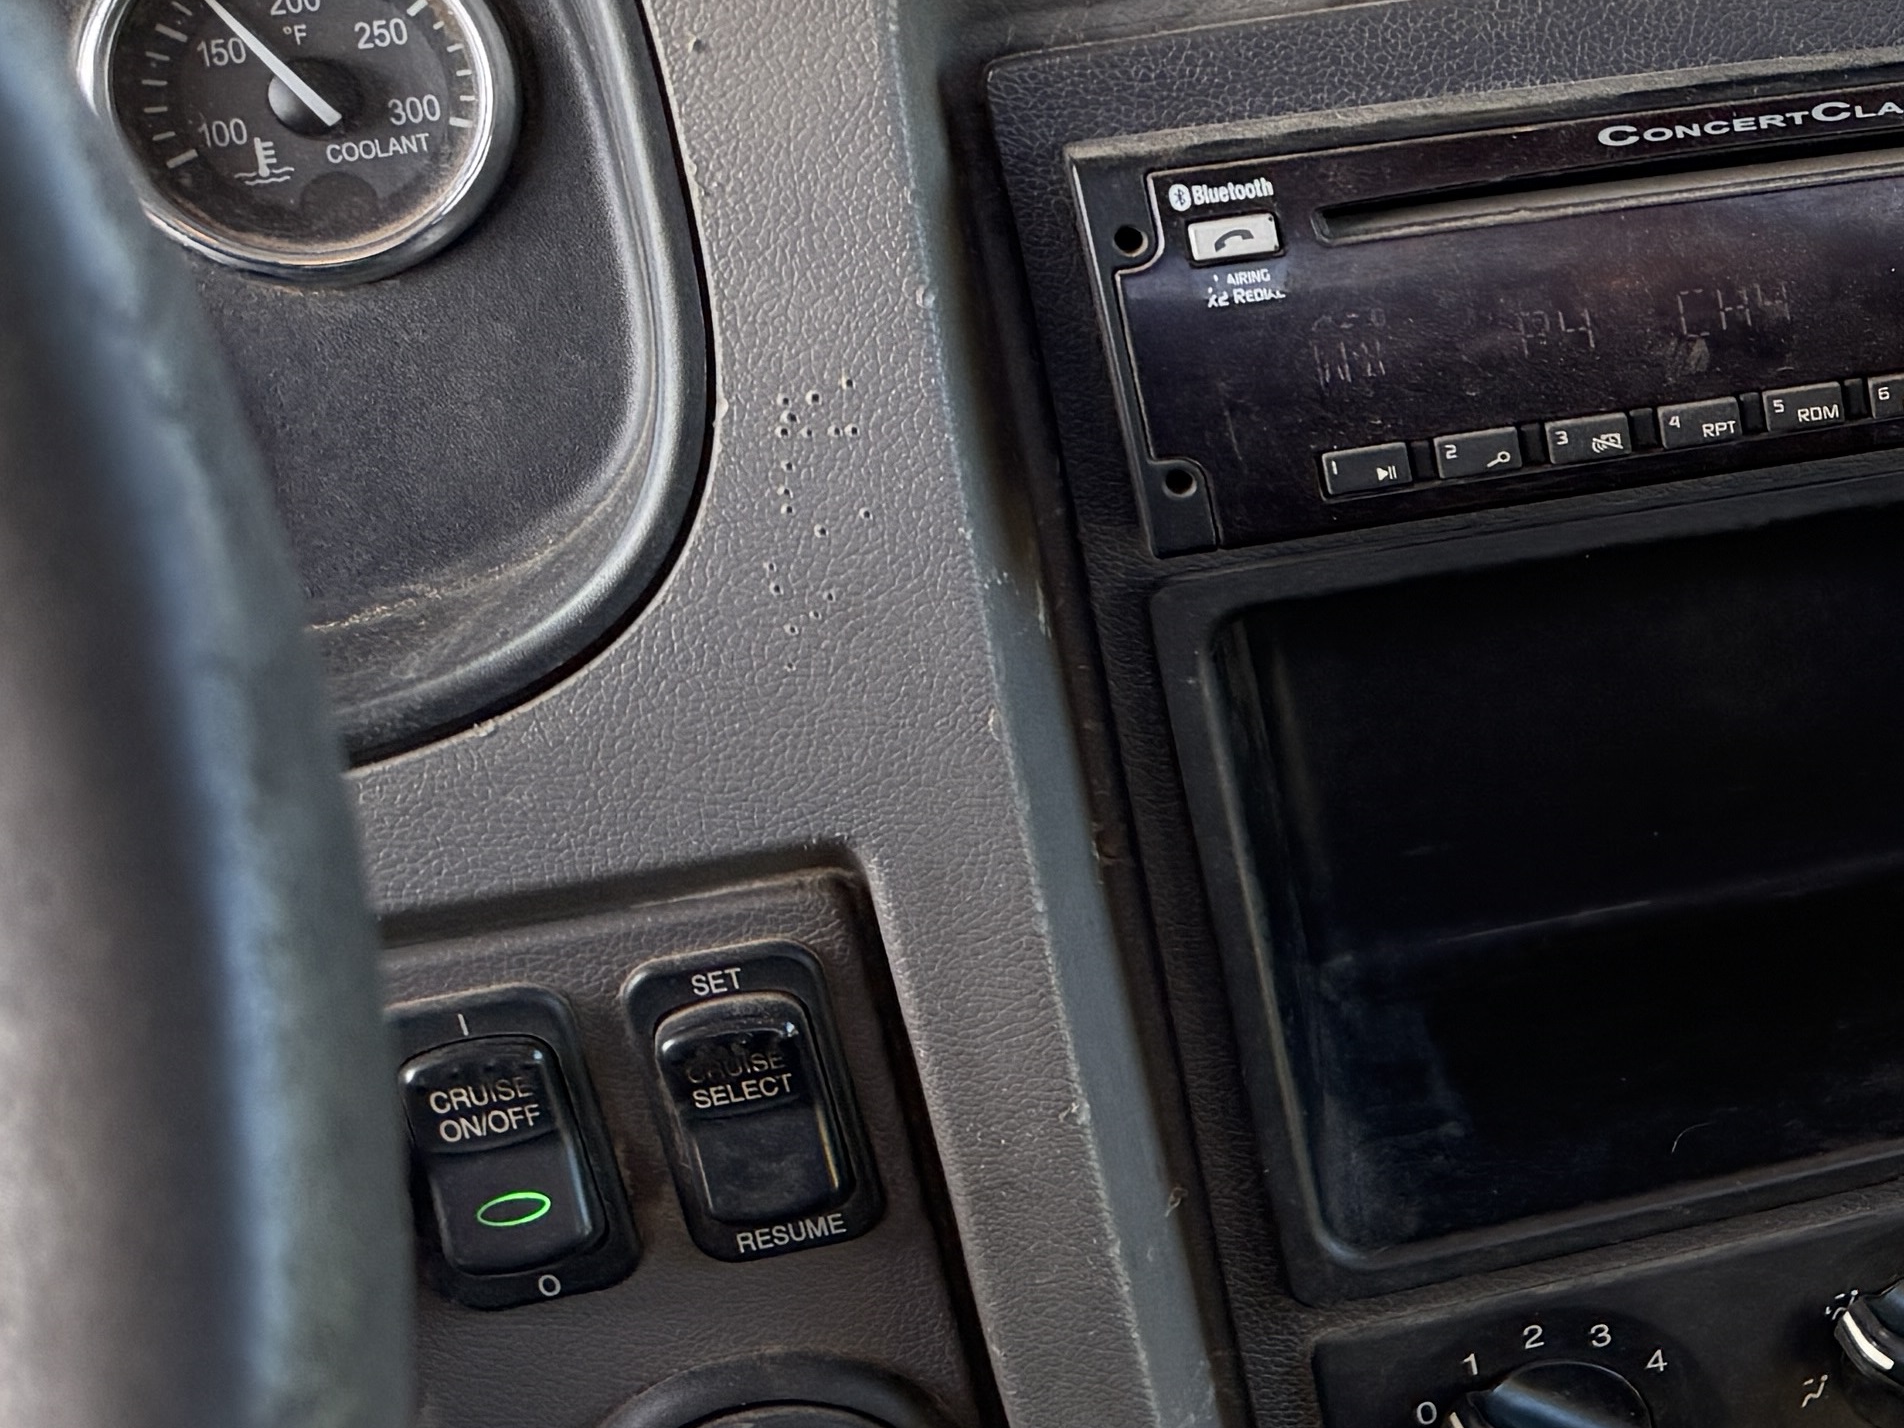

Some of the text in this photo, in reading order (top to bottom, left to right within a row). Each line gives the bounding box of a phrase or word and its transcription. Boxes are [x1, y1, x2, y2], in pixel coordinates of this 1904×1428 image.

[354, 18, 408, 50] 250
[197, 36, 247, 68] 150
[388, 94, 441, 126] 300
[197, 118, 248, 149] 100
[325, 133, 431, 164] COOLANT
[1191, 176, 1274, 205] Bluetooth
[1213, 268, 1271, 287] AIRING
[1877, 386, 1890, 402] 6
[1773, 400, 1840, 423] 5 RDM
[1555, 430, 1569, 446] 3
[1667, 415, 1737, 439] 4 RPT
[1445, 444, 1459, 460] 2
[691, 967, 742, 997] SET
[429, 1077, 535, 1115] CRUISE
[692, 1073, 792, 1109] SELECT
[438, 1104, 541, 1144] ON/OFF
[736, 1213, 847, 1254] RESUME
[1522, 1325, 1545, 1349] 2
[1589, 1323, 1612, 1348] 3
[1462, 1352, 1480, 1376] 1
[1646, 1348, 1668, 1373] 4
